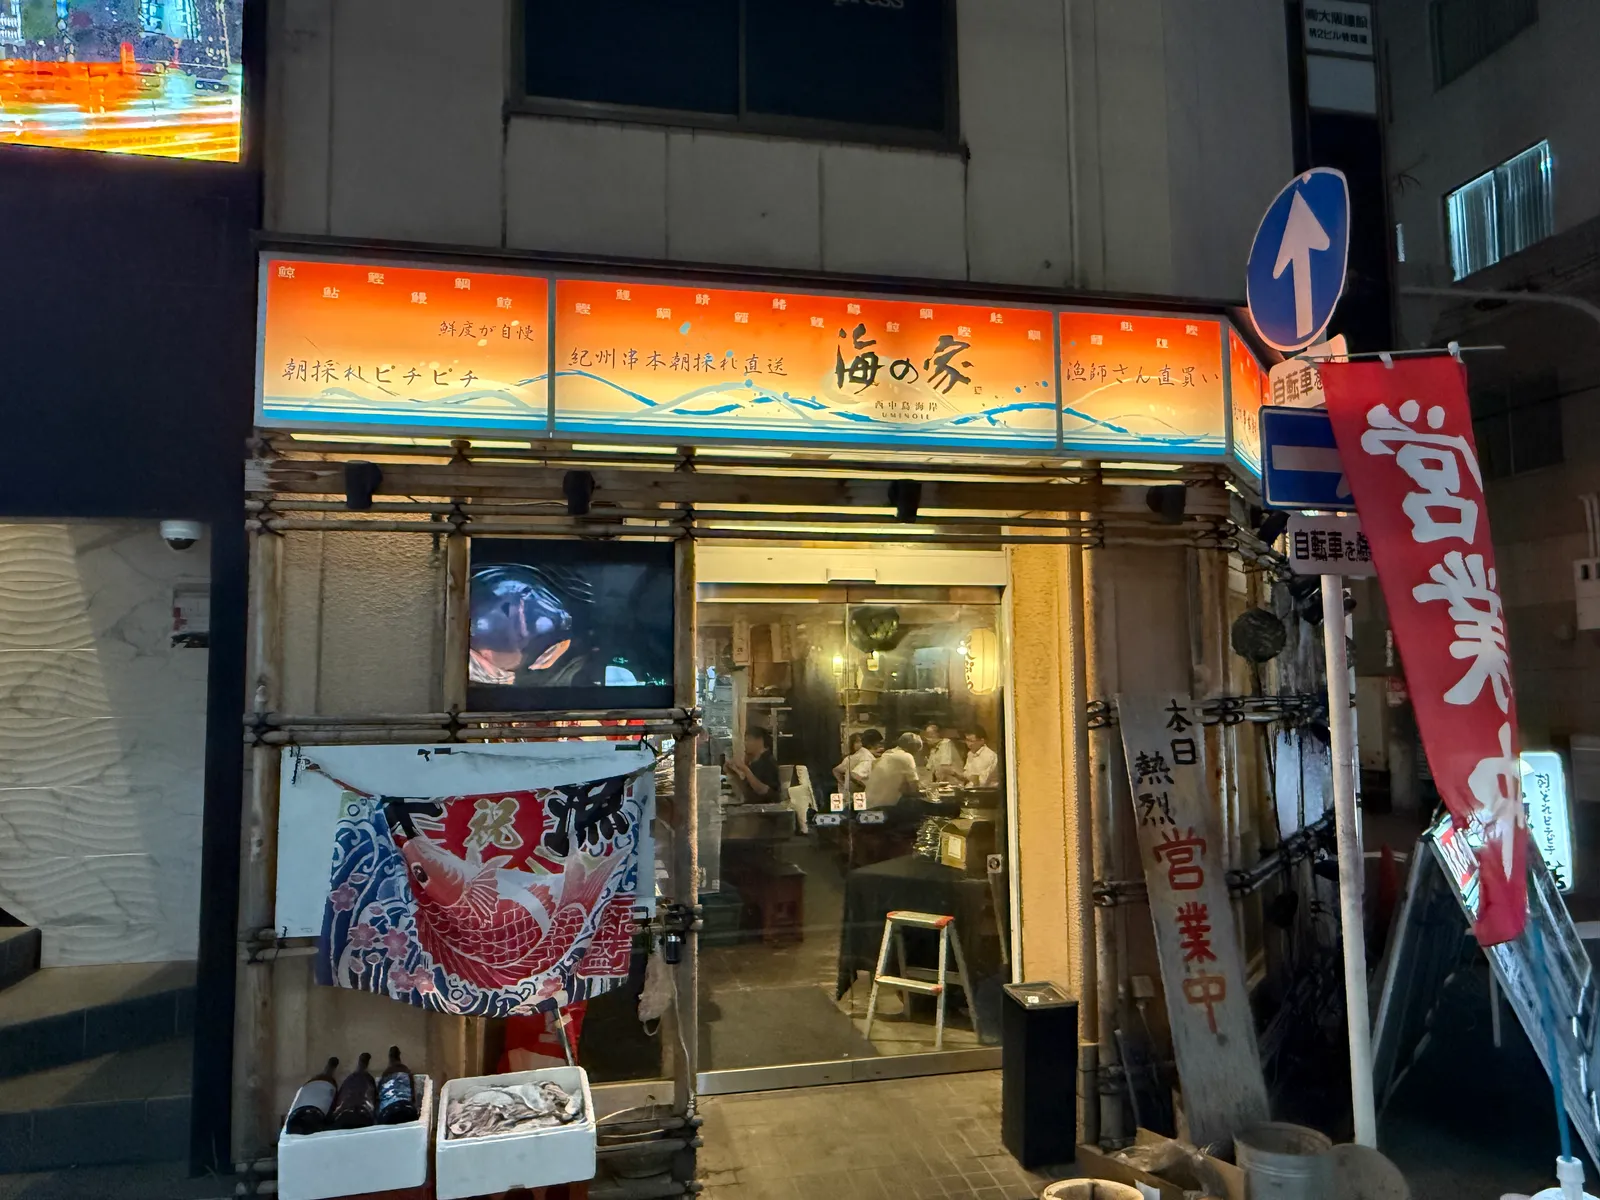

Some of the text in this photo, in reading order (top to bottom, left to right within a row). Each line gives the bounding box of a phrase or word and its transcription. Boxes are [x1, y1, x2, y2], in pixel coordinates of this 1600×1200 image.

[322, 286, 340, 299] 鮎
[438, 320, 535, 342] 鮮度が自慢
[834, 322, 975, 396] 海の家
[1066, 360, 1220, 388] 漁師さん直買い
[1360, 398, 1525, 882] 営業中
[1164, 698, 1198, 766] 本日
[1134, 749, 1176, 828] 熱烈
[1152, 825, 1227, 1040] 営業中
